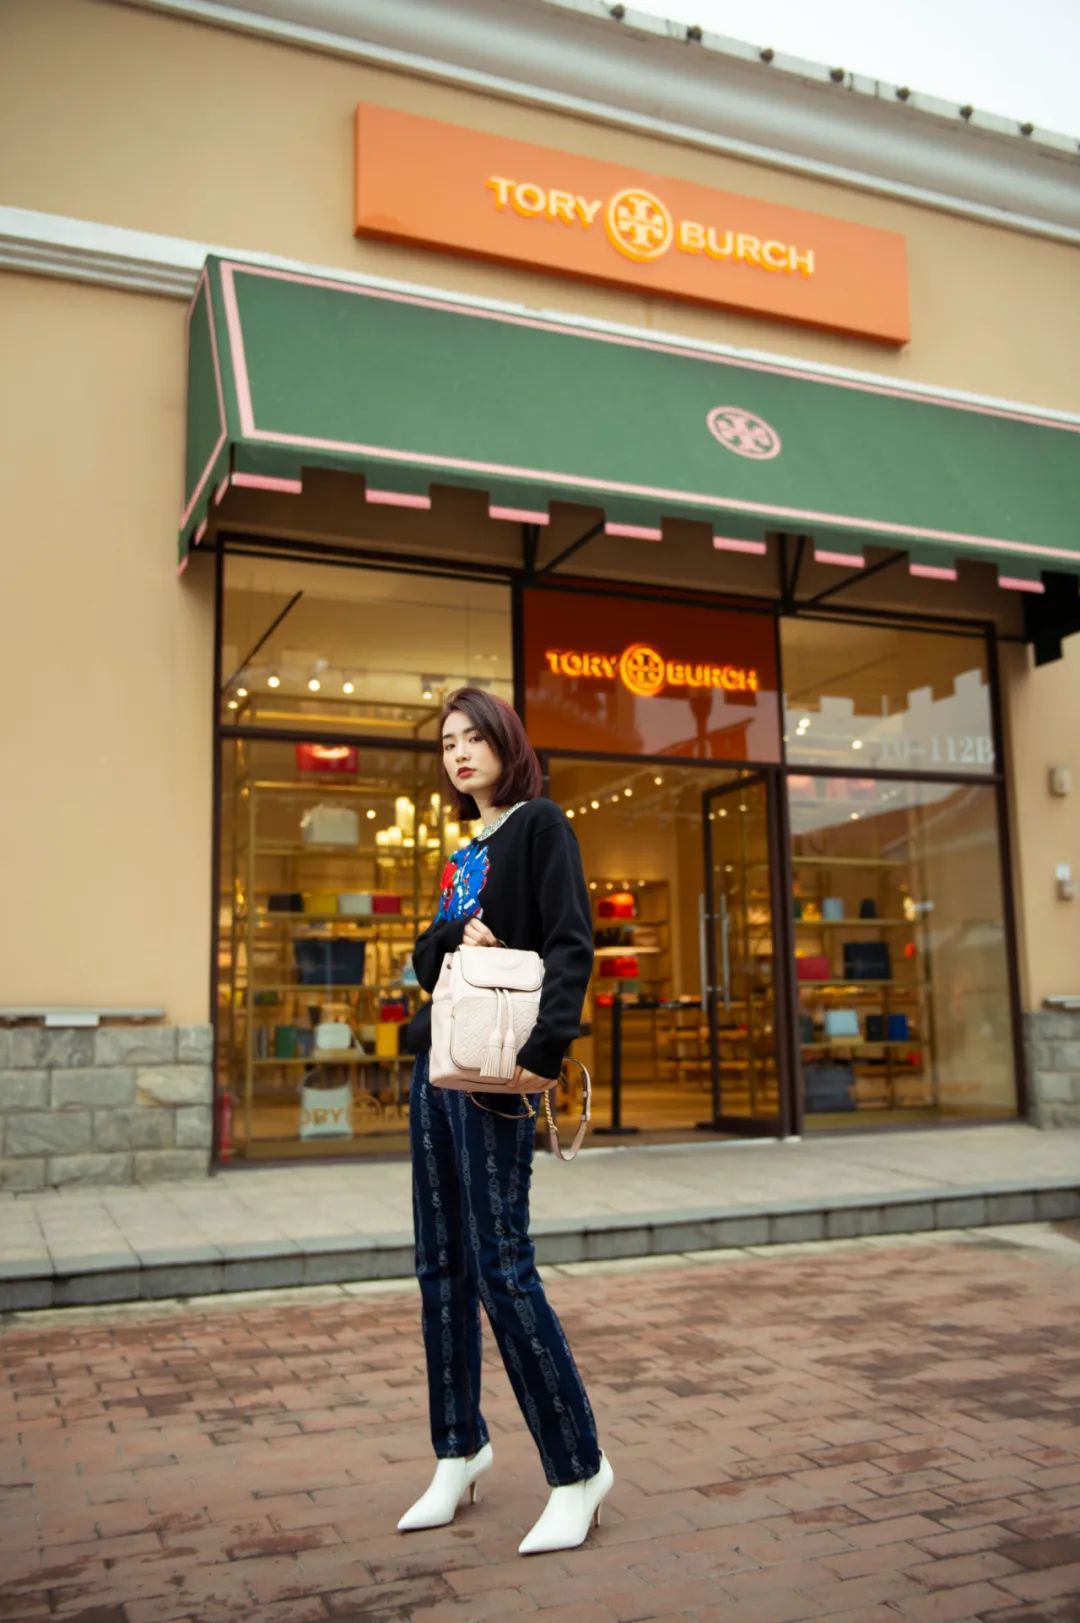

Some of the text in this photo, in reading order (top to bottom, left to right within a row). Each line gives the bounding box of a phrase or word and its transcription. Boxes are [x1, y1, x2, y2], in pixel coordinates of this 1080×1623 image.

[486, 176, 815, 278] TORY BURCH
[545, 651, 758, 692] TORY BURCH
